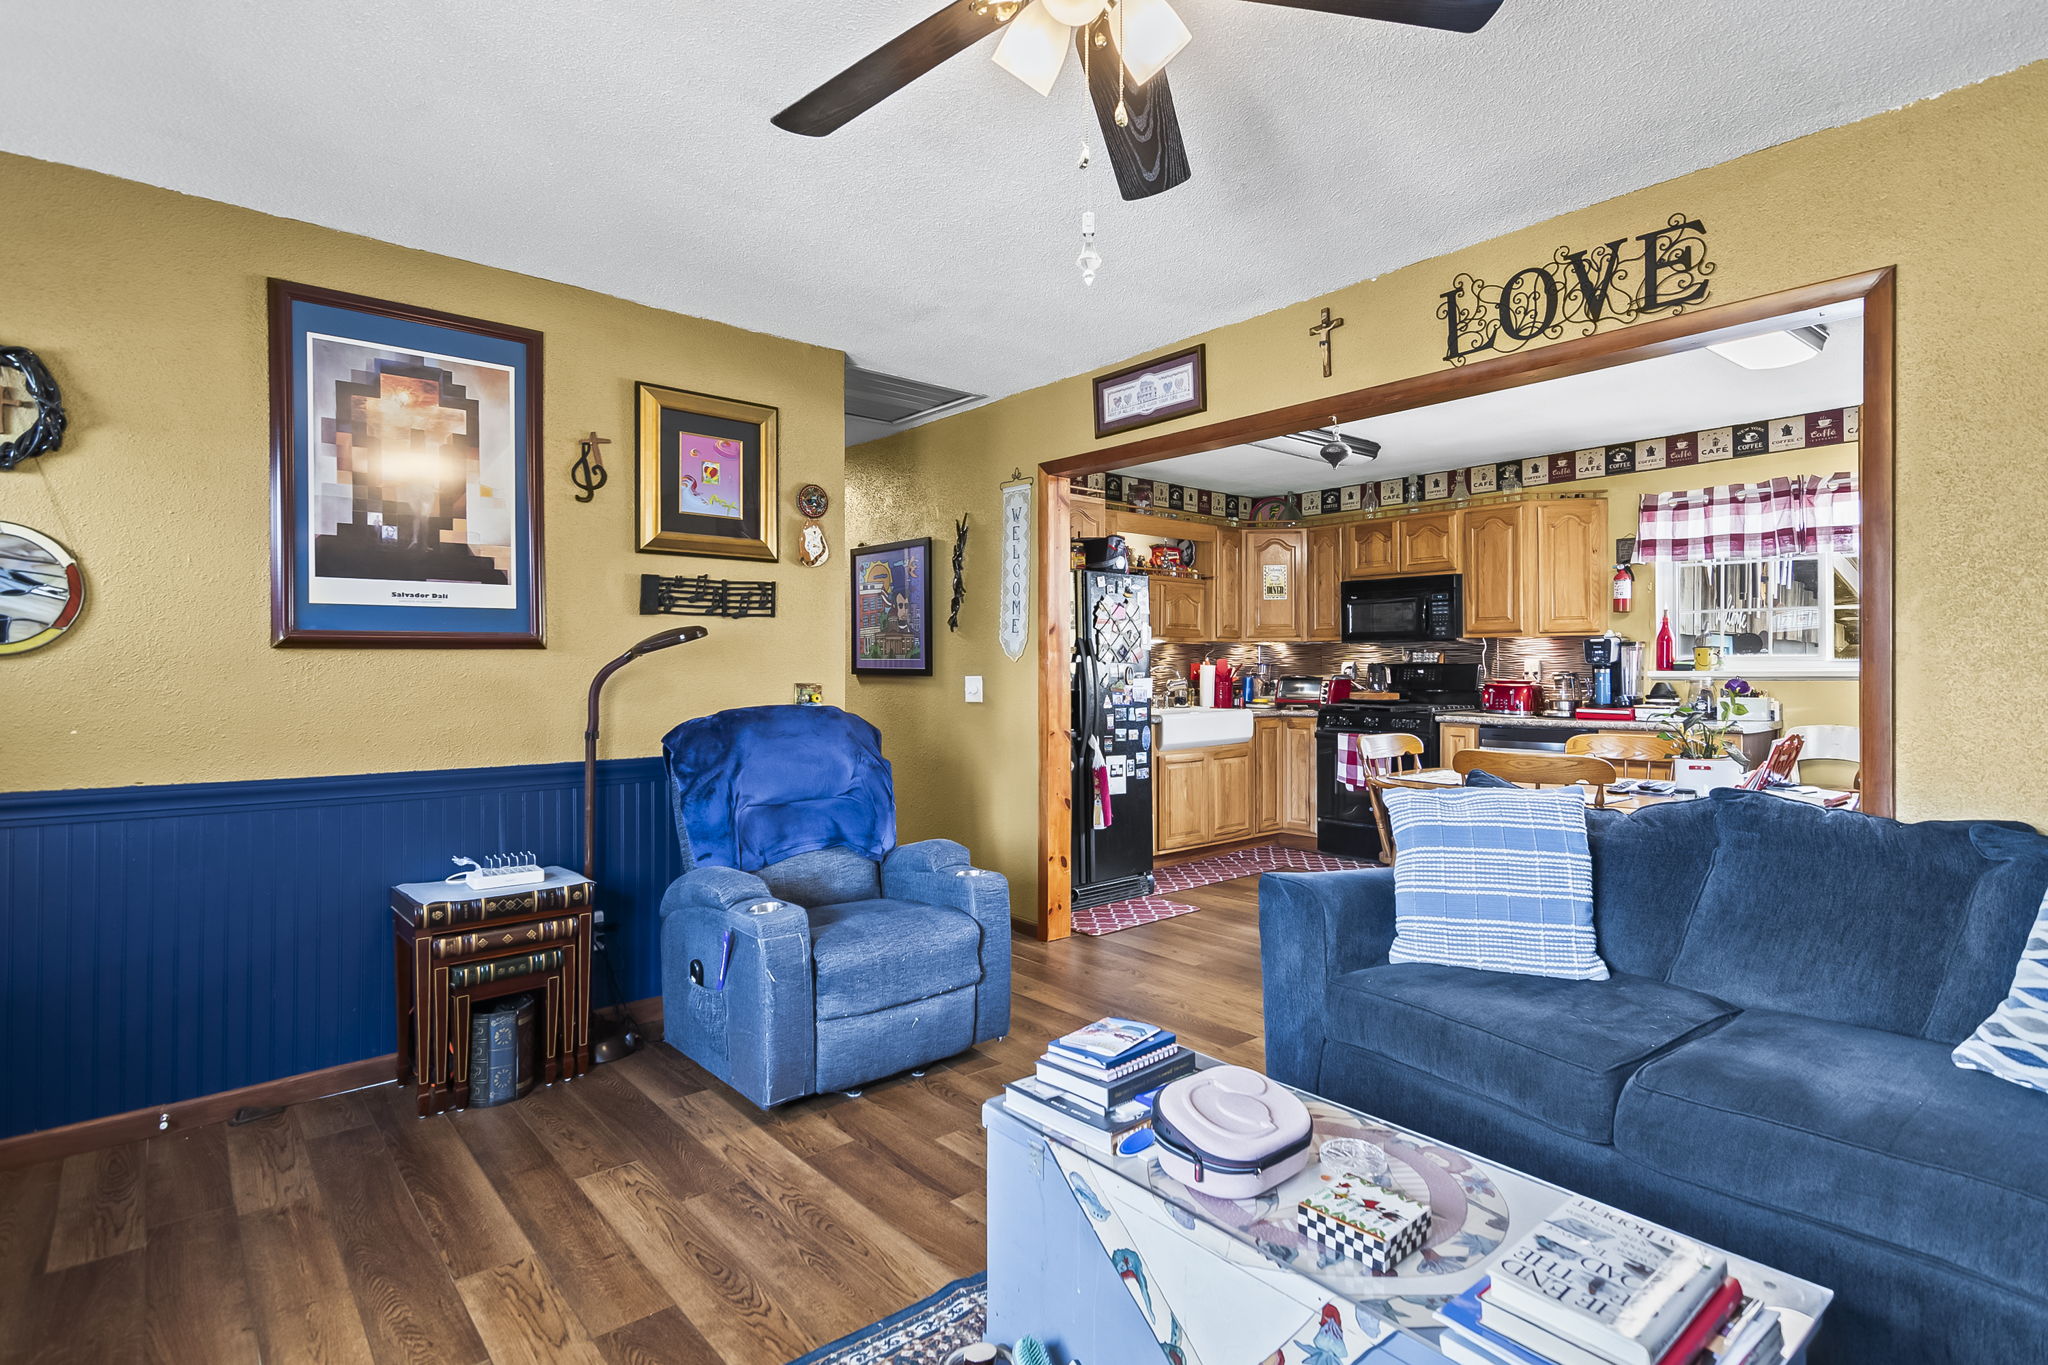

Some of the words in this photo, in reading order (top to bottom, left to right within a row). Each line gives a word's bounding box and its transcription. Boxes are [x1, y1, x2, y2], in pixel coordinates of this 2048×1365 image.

[1437, 213, 1714, 365] LOVE
[1701, 443, 1729, 456] CAFÉ
[1737, 442, 1764, 451] COFFEE
[1578, 462, 1602, 473] CAFÉ
[1608, 461, 1632, 469] COFFEE
[1473, 478, 1494, 488] CAFÉ
[1011, 506, 1022, 634] WELCOME
[391, 591, 430, 599] Salvador
[1513, 1246, 1573, 1283] THE
[1501, 1259, 1573, 1301] END
[1580, 1257, 1646, 1290] OAD
